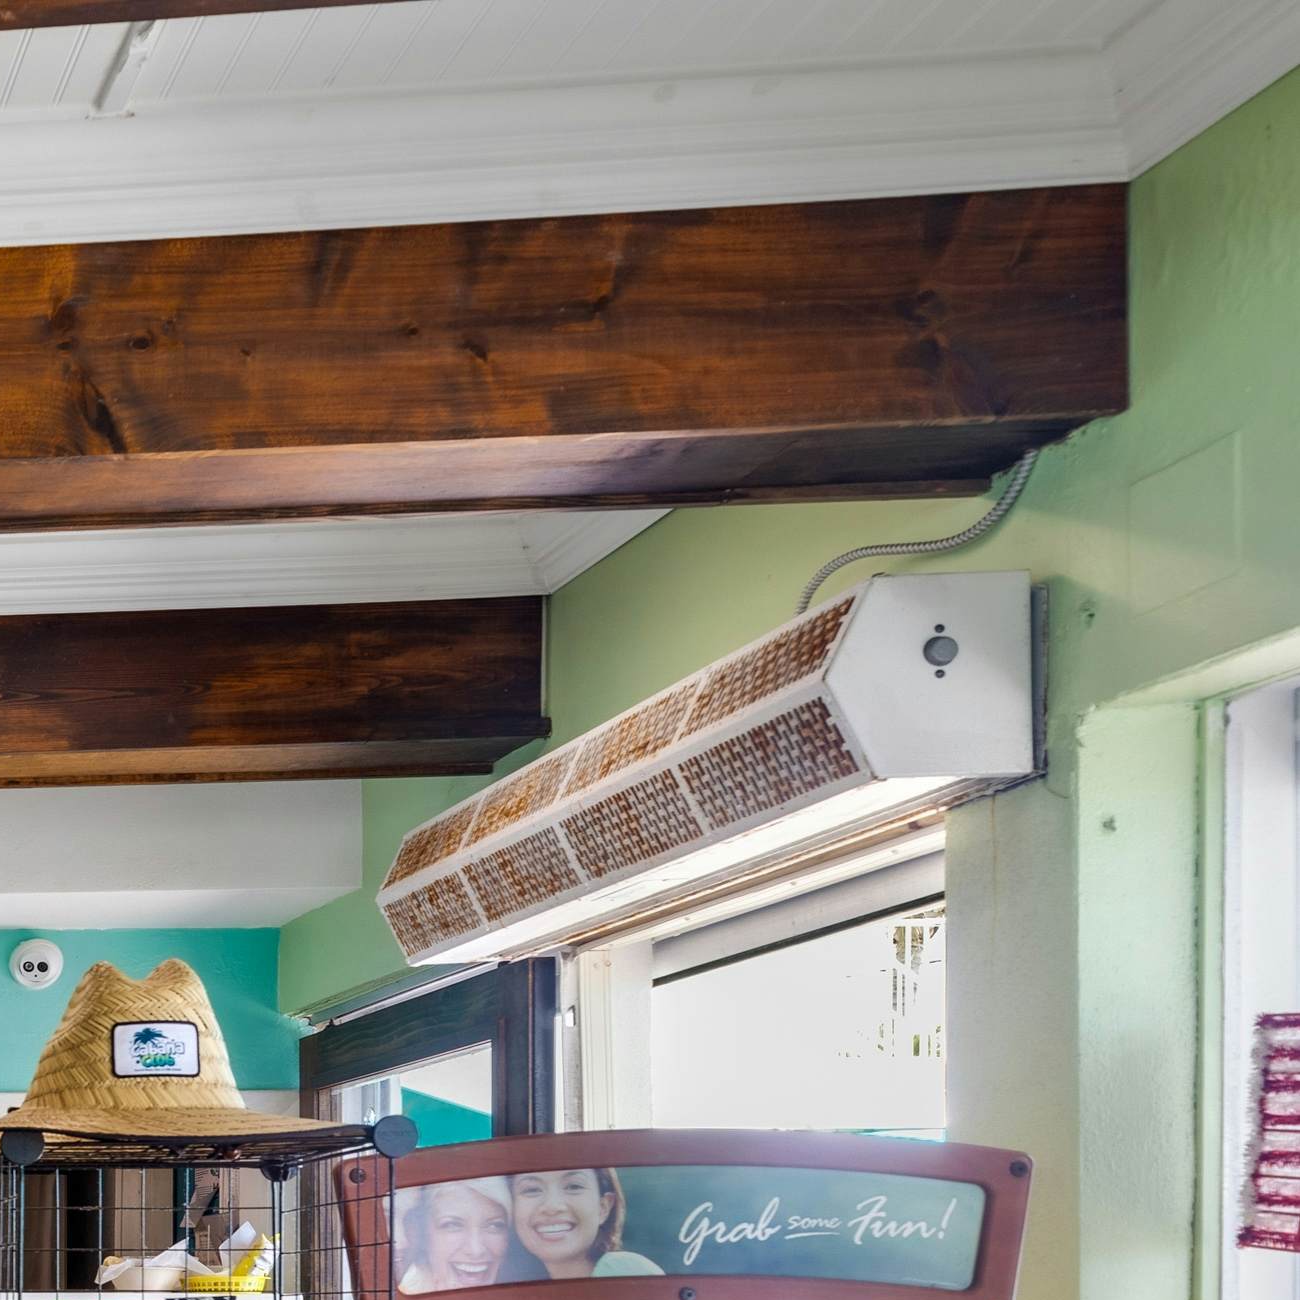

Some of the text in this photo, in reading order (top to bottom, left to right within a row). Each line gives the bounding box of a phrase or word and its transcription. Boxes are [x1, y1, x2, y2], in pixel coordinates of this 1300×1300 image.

[679, 1196, 958, 1266] Grab some Fun!
